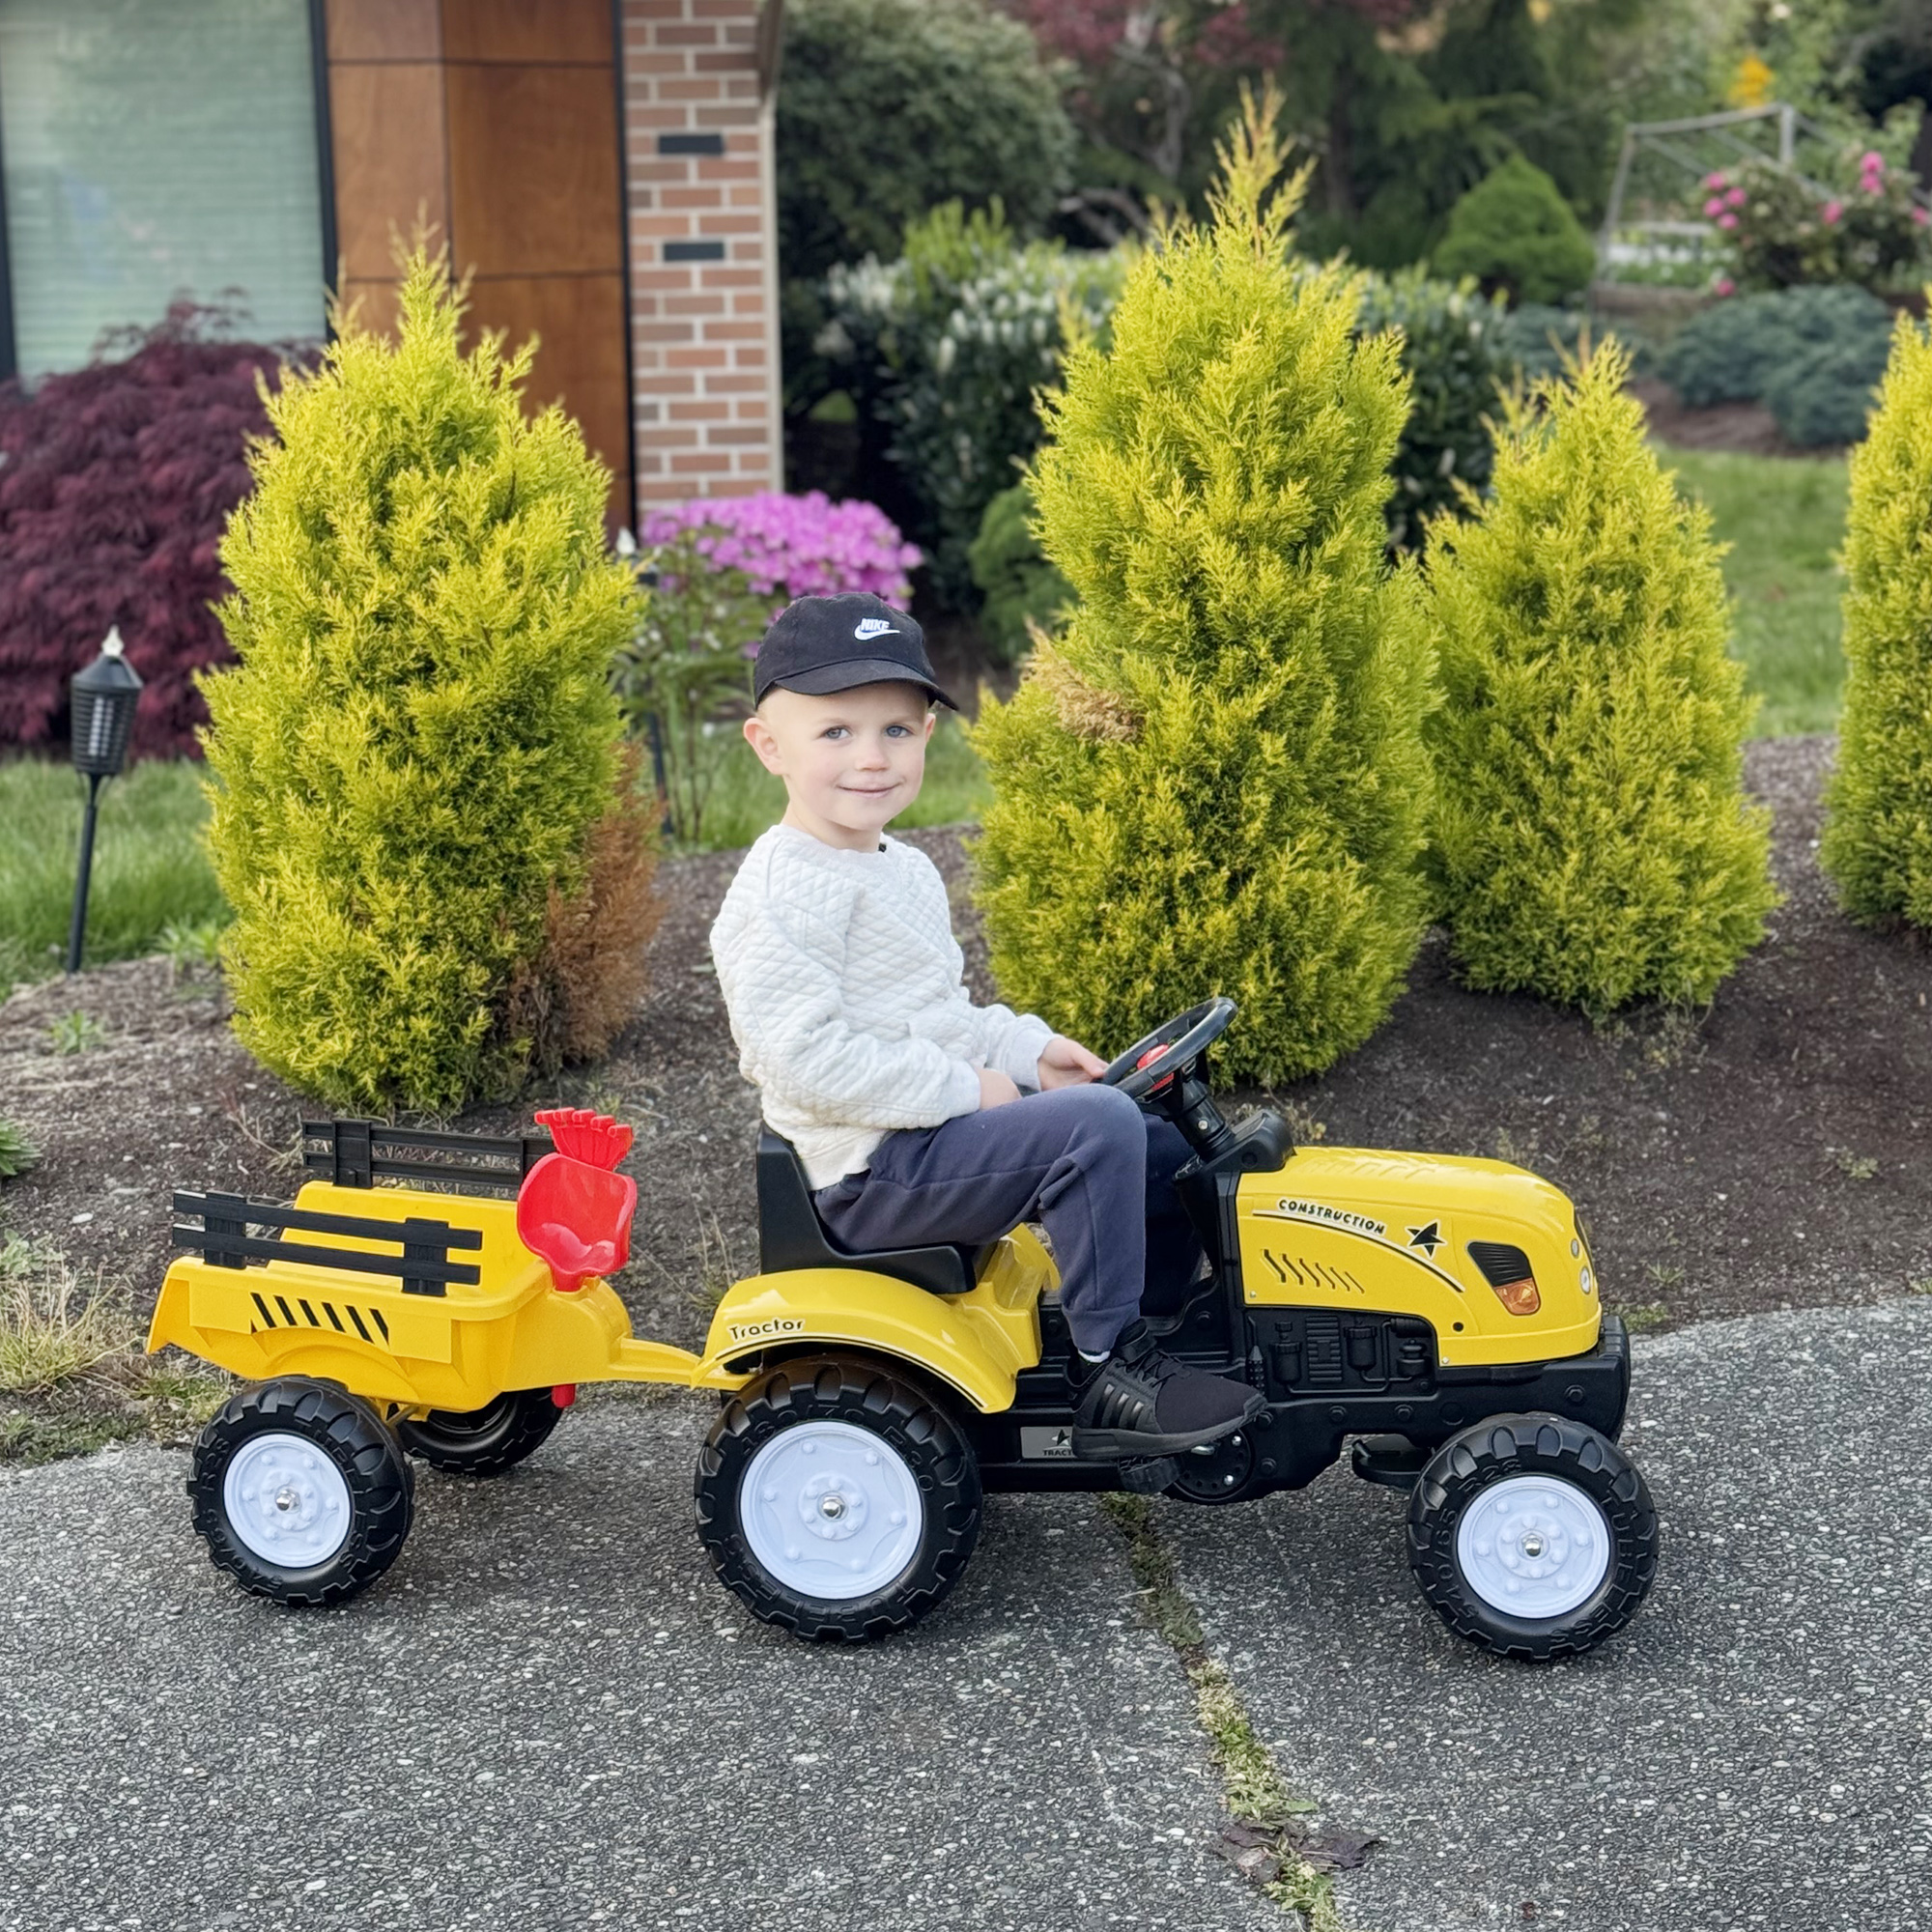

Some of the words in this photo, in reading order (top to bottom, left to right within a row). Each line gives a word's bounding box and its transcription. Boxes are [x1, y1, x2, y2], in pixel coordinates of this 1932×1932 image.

[860, 617, 890, 631] NIKE
[1278, 1199, 1385, 1235] CONSTRUCTION
[729, 1319, 804, 1340] Tractor
